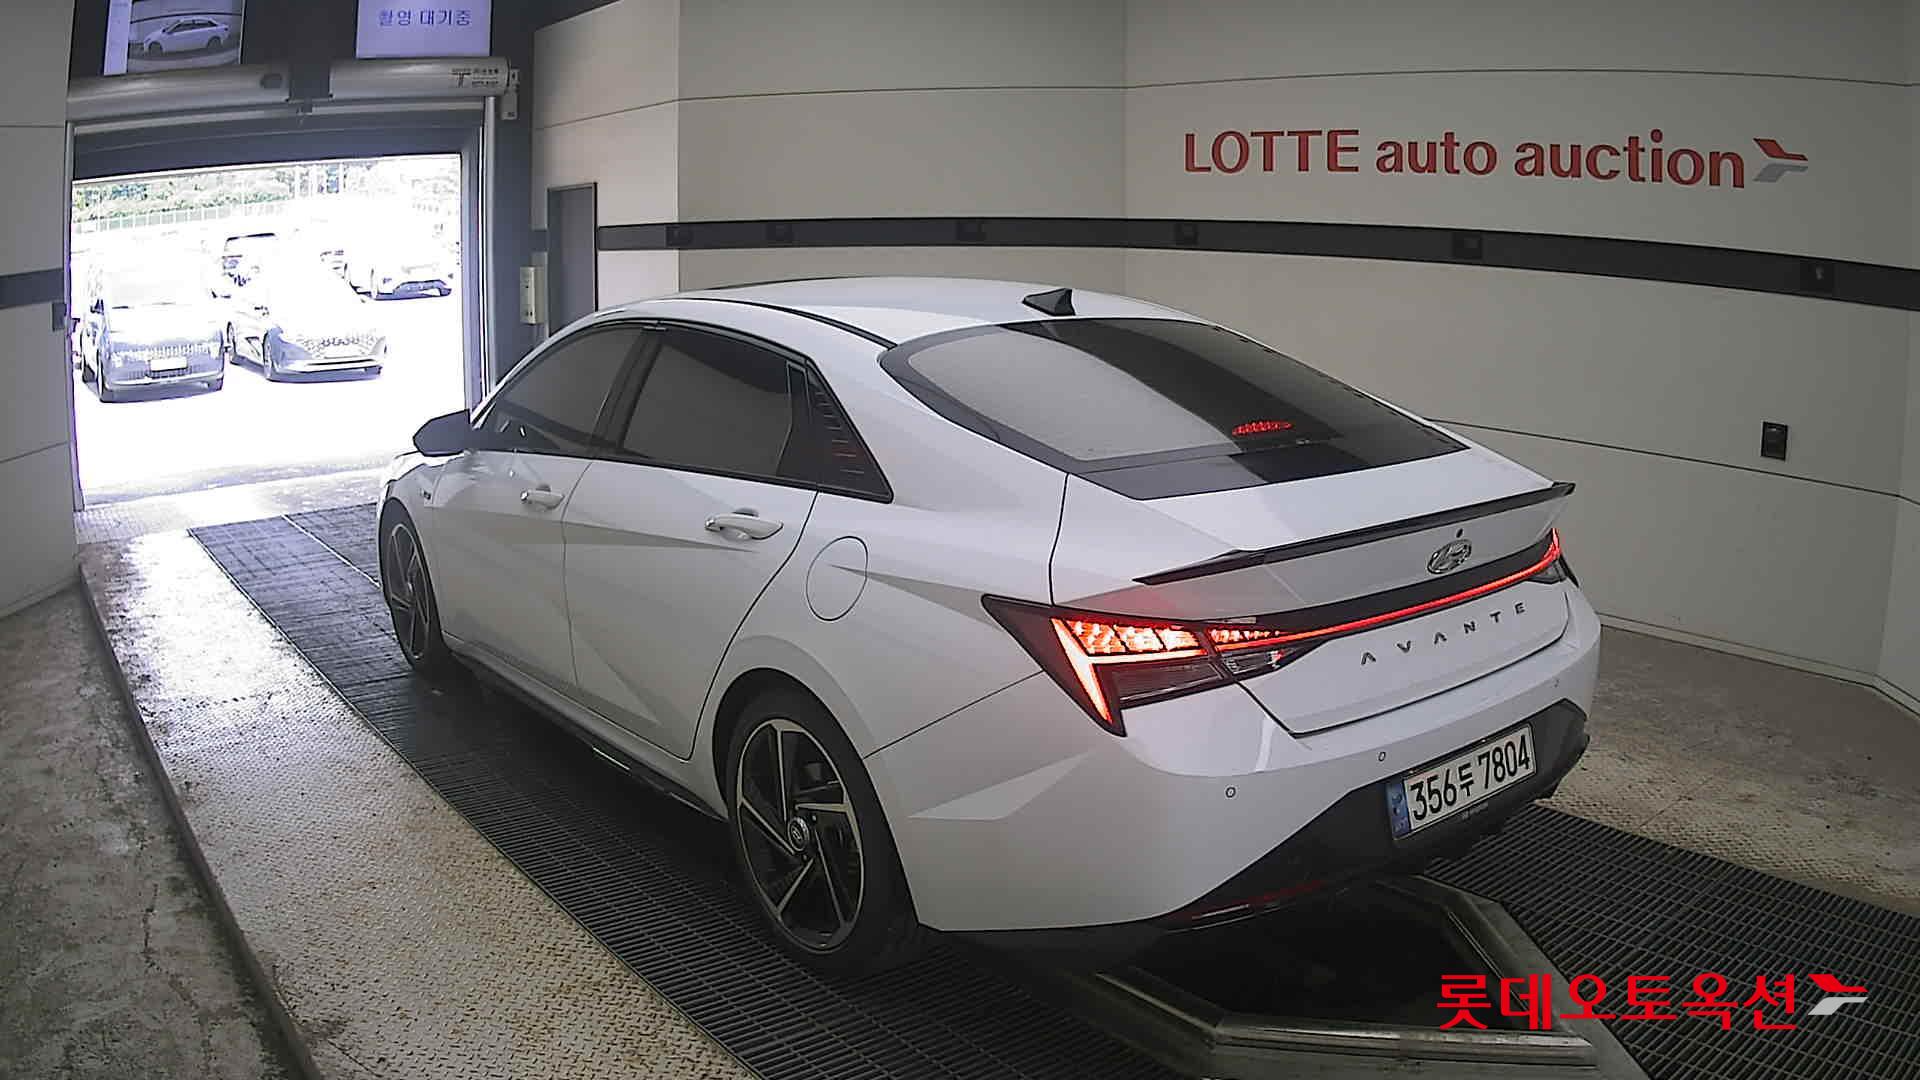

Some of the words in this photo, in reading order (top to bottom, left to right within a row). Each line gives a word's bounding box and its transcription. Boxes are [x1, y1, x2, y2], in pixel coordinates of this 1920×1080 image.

[420, 8, 472, 27] 대기중
[1184, 129, 1360, 175] LOTTE
[1376, 132, 1499, 176] auto
[1514, 129, 1745, 188] auction
[1360, 602, 1526, 666] AVANTE
[1477, 734, 1531, 790] 7804
